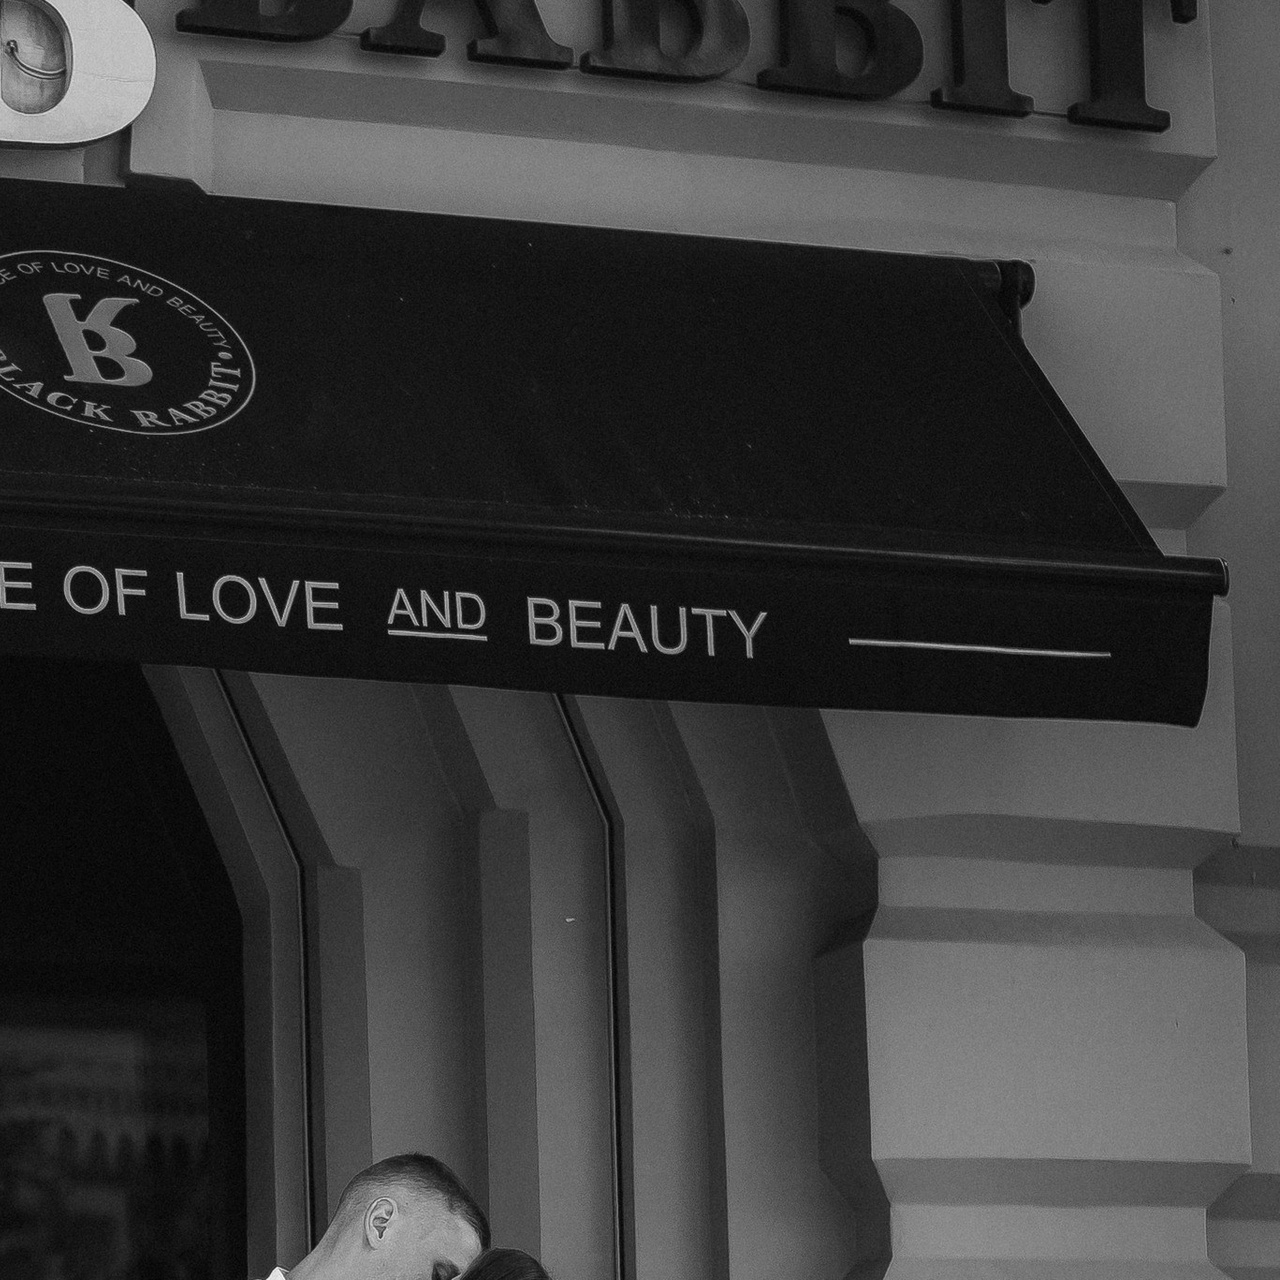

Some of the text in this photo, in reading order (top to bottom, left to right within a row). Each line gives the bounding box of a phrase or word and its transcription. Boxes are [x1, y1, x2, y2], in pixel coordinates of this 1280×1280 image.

[17, 261, 43, 274] OF
[51, 261, 109, 279] LOVE
[116, 274, 164, 297] AND
[166, 295, 232, 350] BEAUTY
[130, 361, 241, 428] RABBIT
[62, 565, 148, 617] OF
[176, 571, 344, 631] LOVE
[387, 588, 488, 631] AND
[527, 596, 768, 659] BEAUTY
